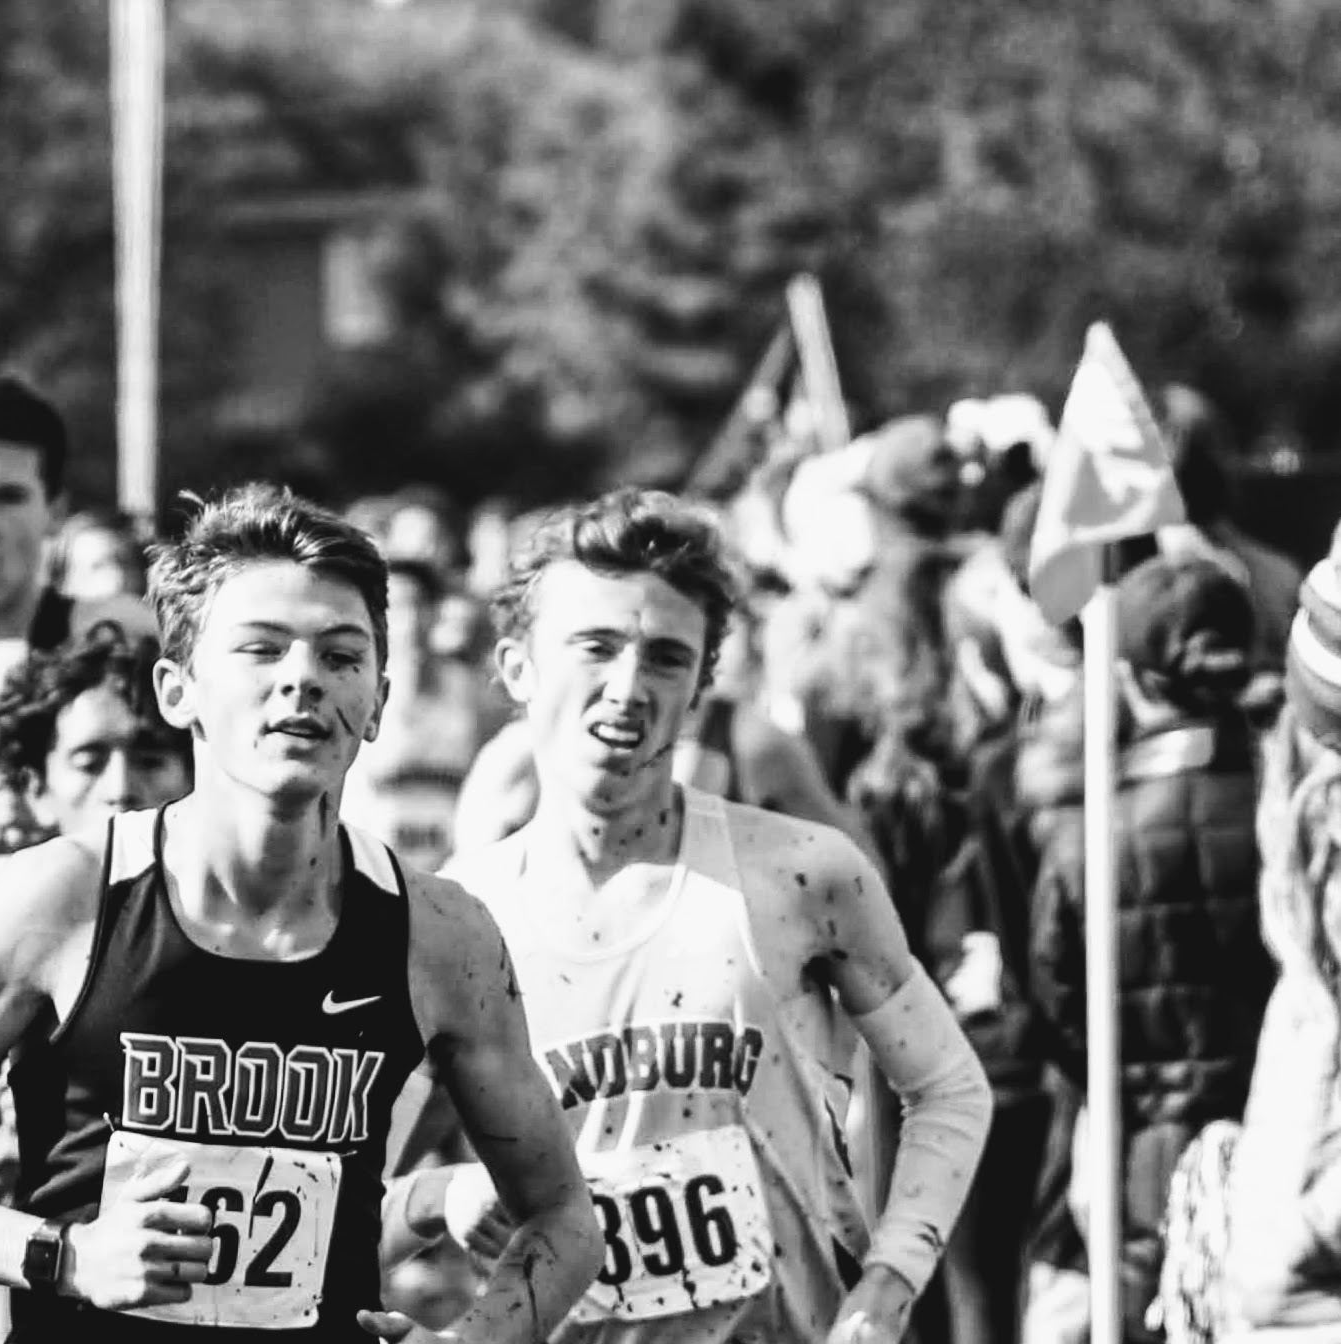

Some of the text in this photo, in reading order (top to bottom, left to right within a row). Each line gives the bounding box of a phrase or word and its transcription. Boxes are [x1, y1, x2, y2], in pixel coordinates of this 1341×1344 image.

[119, 1031, 385, 1144] BROOK
[544, 1021, 764, 1111] NDBURG
[139, 1185, 295, 1288] 62
